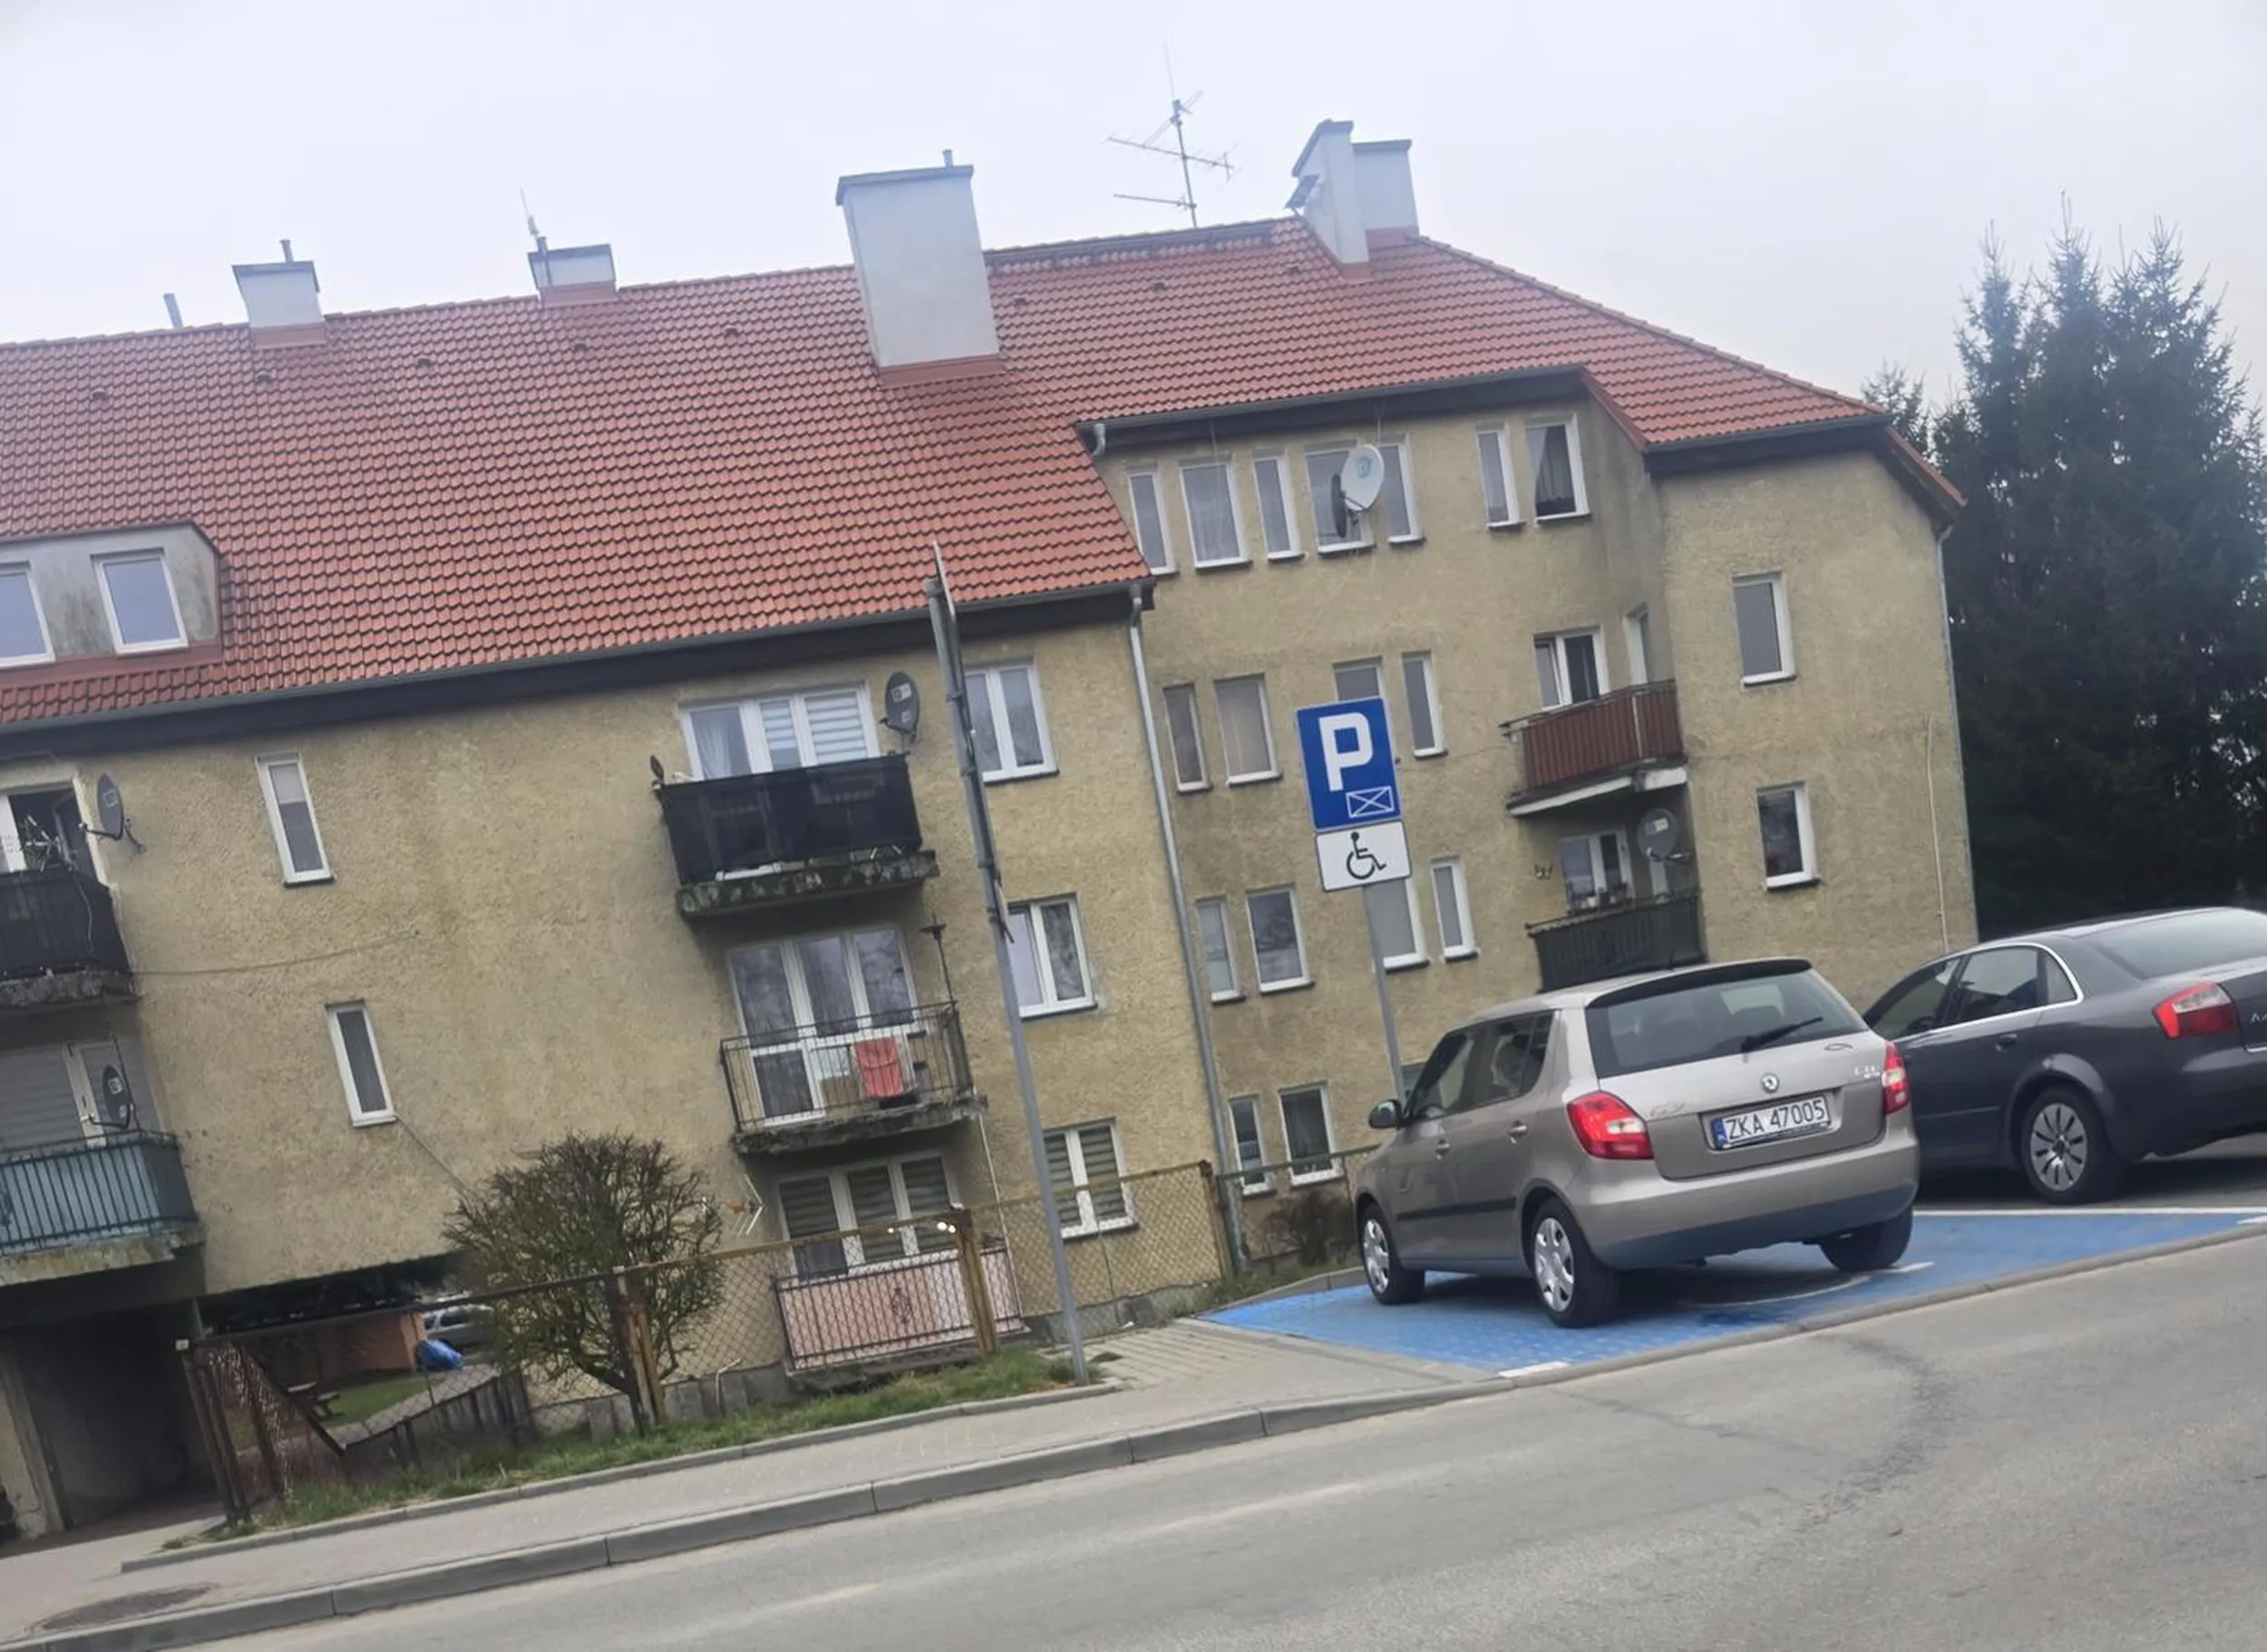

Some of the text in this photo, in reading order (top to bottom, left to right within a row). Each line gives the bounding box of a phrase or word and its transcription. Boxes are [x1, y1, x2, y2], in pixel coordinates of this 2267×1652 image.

[1318, 712, 1373, 791] P
[1726, 1100, 1824, 1139] ZKA 47005
